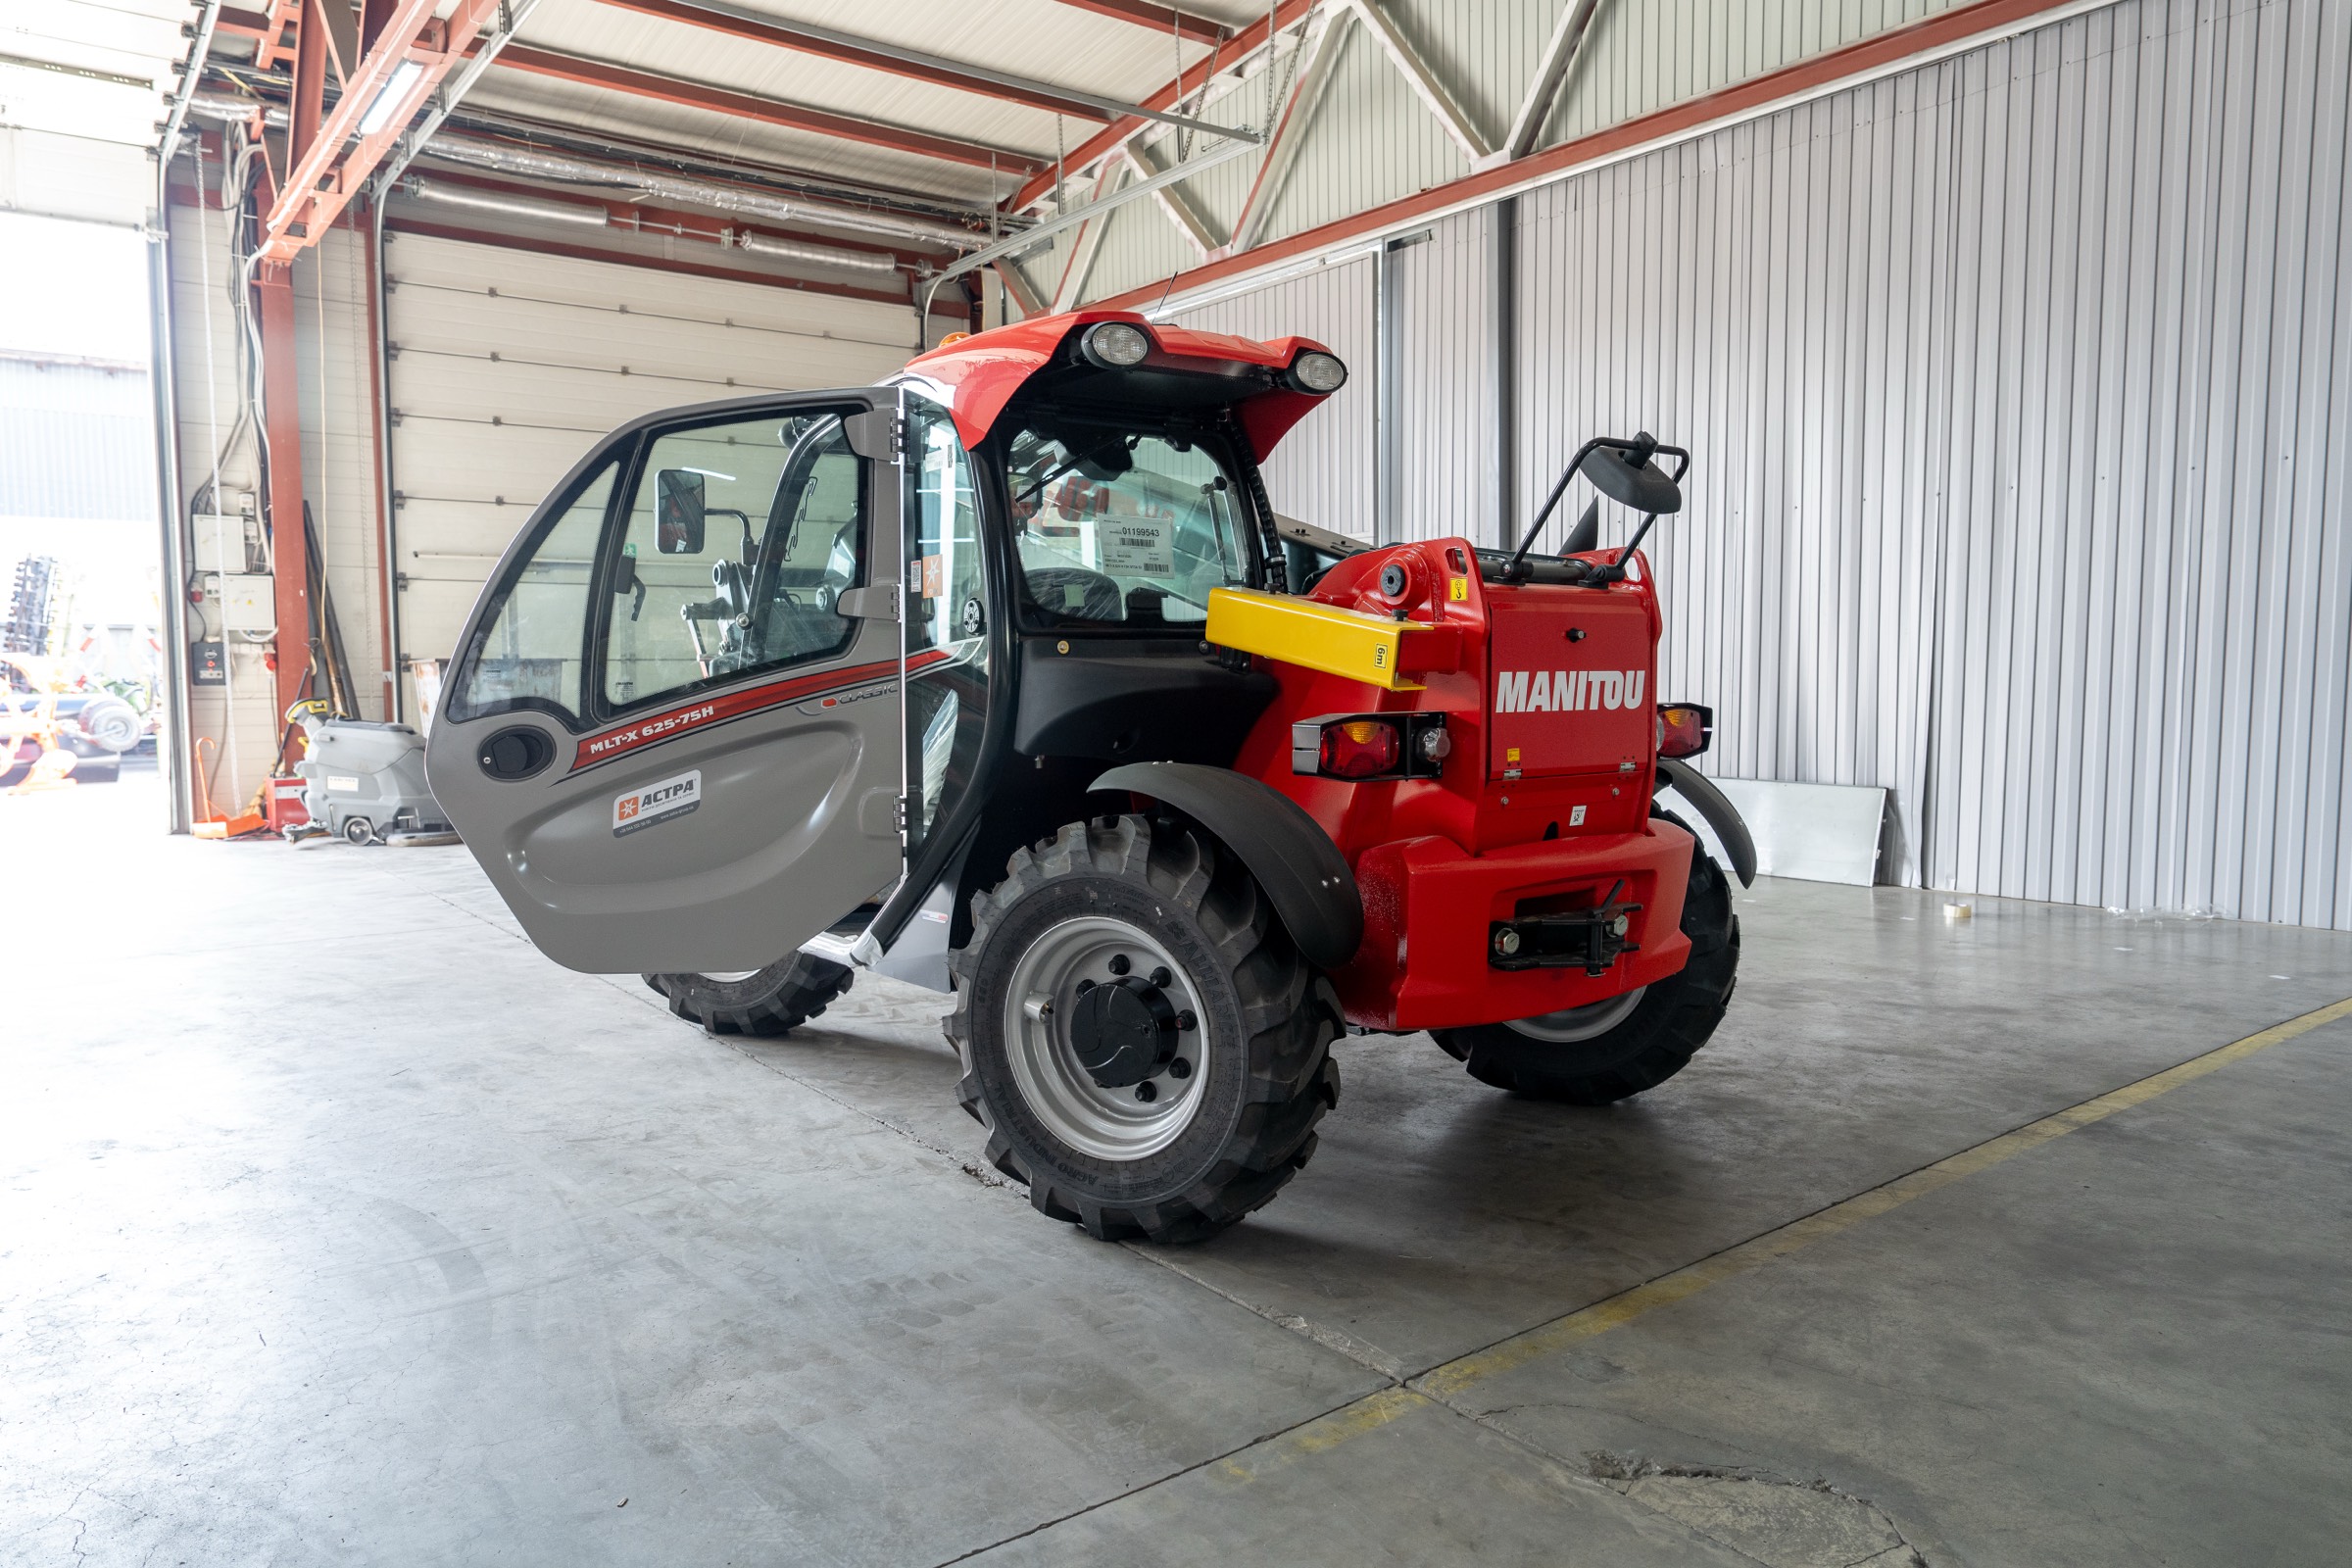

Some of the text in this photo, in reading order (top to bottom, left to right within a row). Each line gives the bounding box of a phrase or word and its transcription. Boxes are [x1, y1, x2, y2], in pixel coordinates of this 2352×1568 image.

[1122, 527, 1159, 537] 01199543
[1377, 647, 1385, 664] 6m
[839, 683, 898, 704] CLASSIC
[1495, 670, 1645, 713] MANITOU
[590, 706, 714, 754] MLT-X 625-75H
[642, 779, 694, 808] АСТРА
[992, 1081, 1057, 1164] INDUSTRIAL
[1057, 1161, 1098, 1187] AGRO
